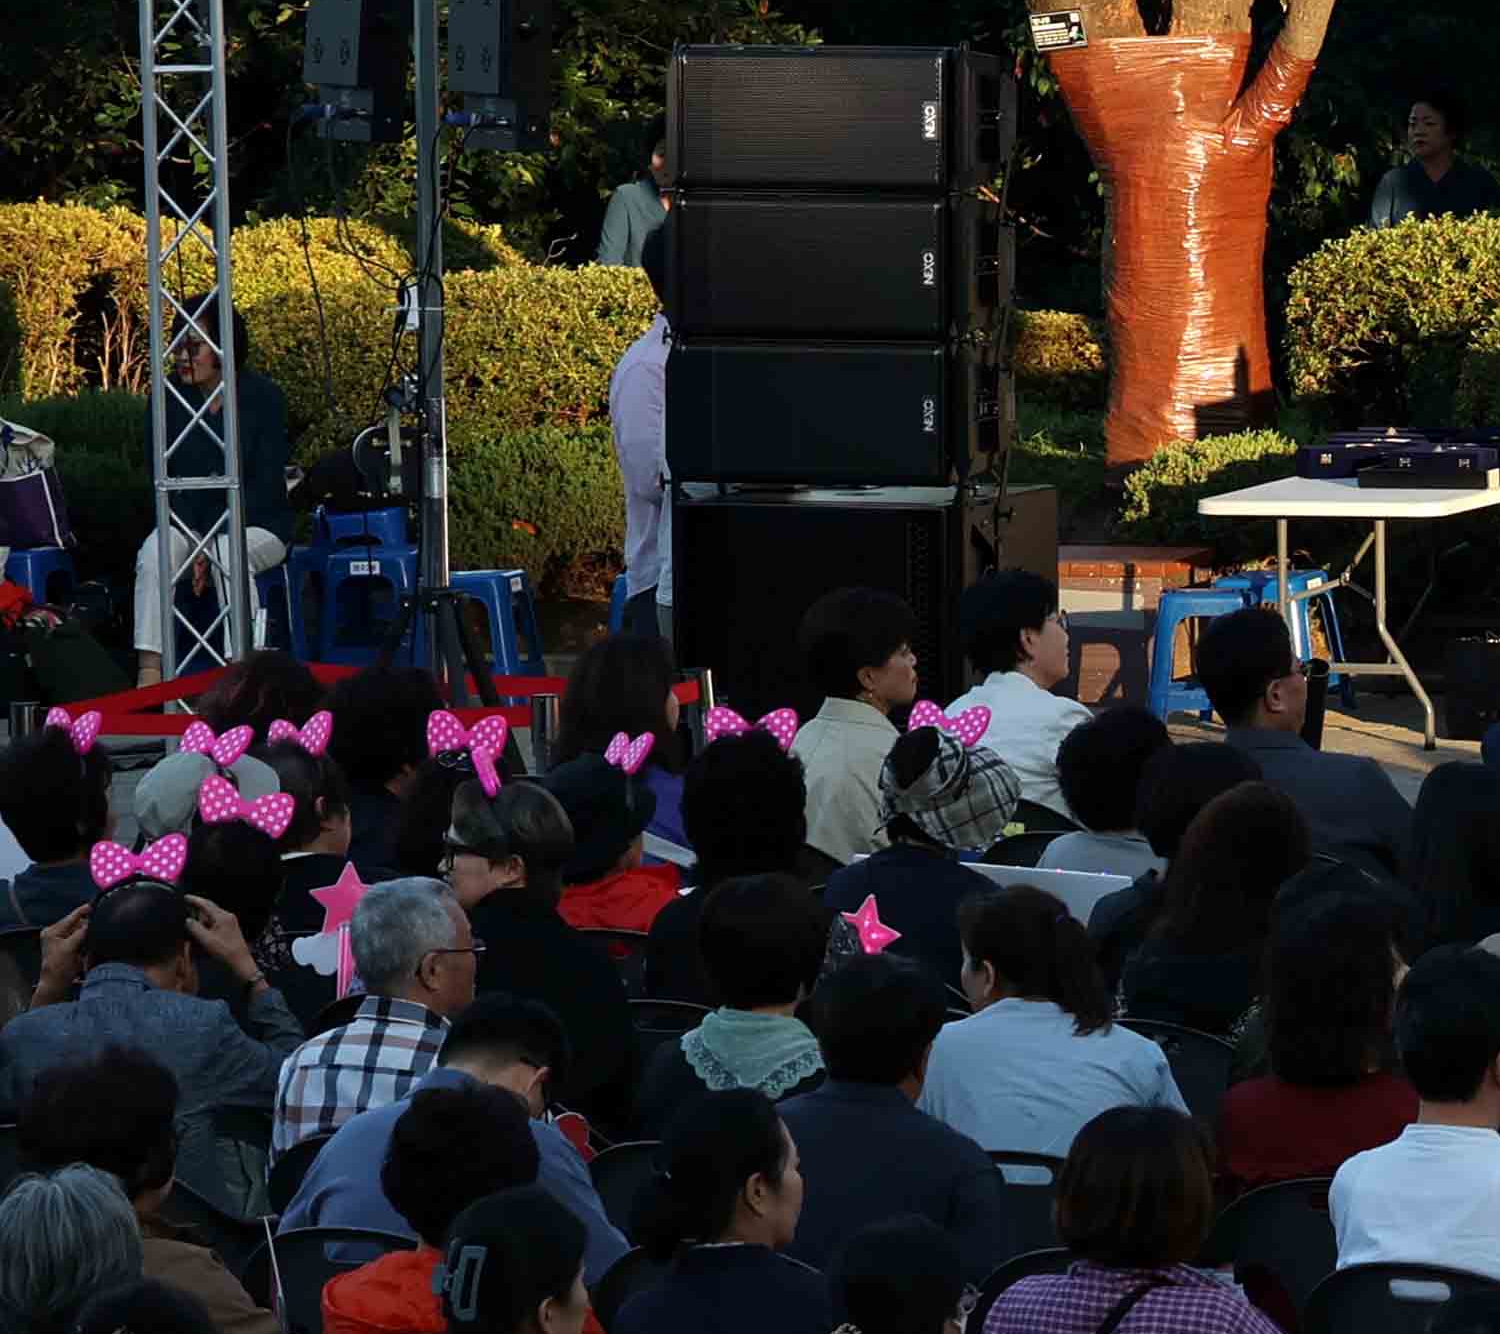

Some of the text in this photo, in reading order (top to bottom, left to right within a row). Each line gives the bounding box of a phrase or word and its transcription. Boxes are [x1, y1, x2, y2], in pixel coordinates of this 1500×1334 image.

[924, 105, 937, 138] NEXO
[923, 252, 935, 285] NEXO
[923, 400, 935, 432] NEXO
